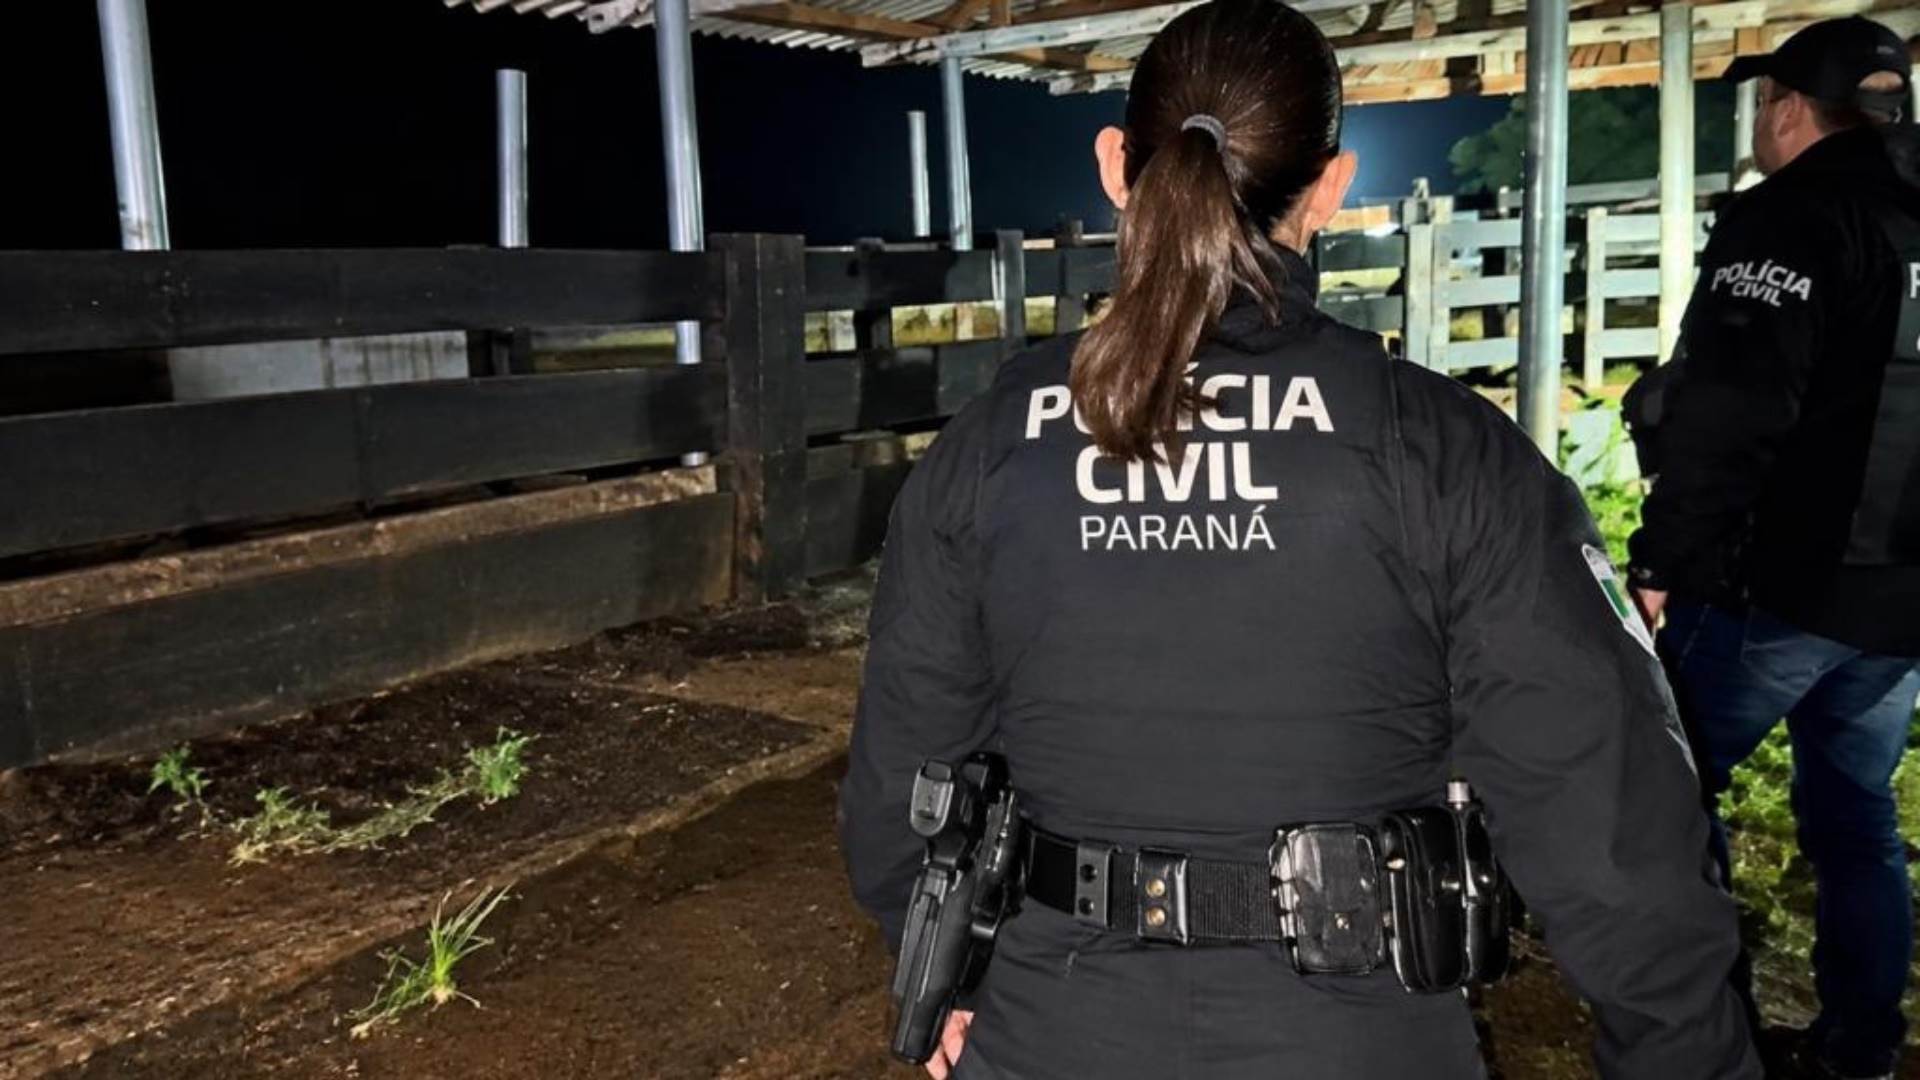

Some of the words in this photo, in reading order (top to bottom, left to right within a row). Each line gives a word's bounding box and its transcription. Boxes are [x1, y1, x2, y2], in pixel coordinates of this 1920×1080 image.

[1711, 259, 1812, 300] POLÍCIA
[1732, 281, 1782, 307] CIVIL
[1025, 361, 1334, 439] PÍCIA
[1075, 442, 1279, 504] CIVIL
[1079, 504, 1276, 551] PARANÁ
